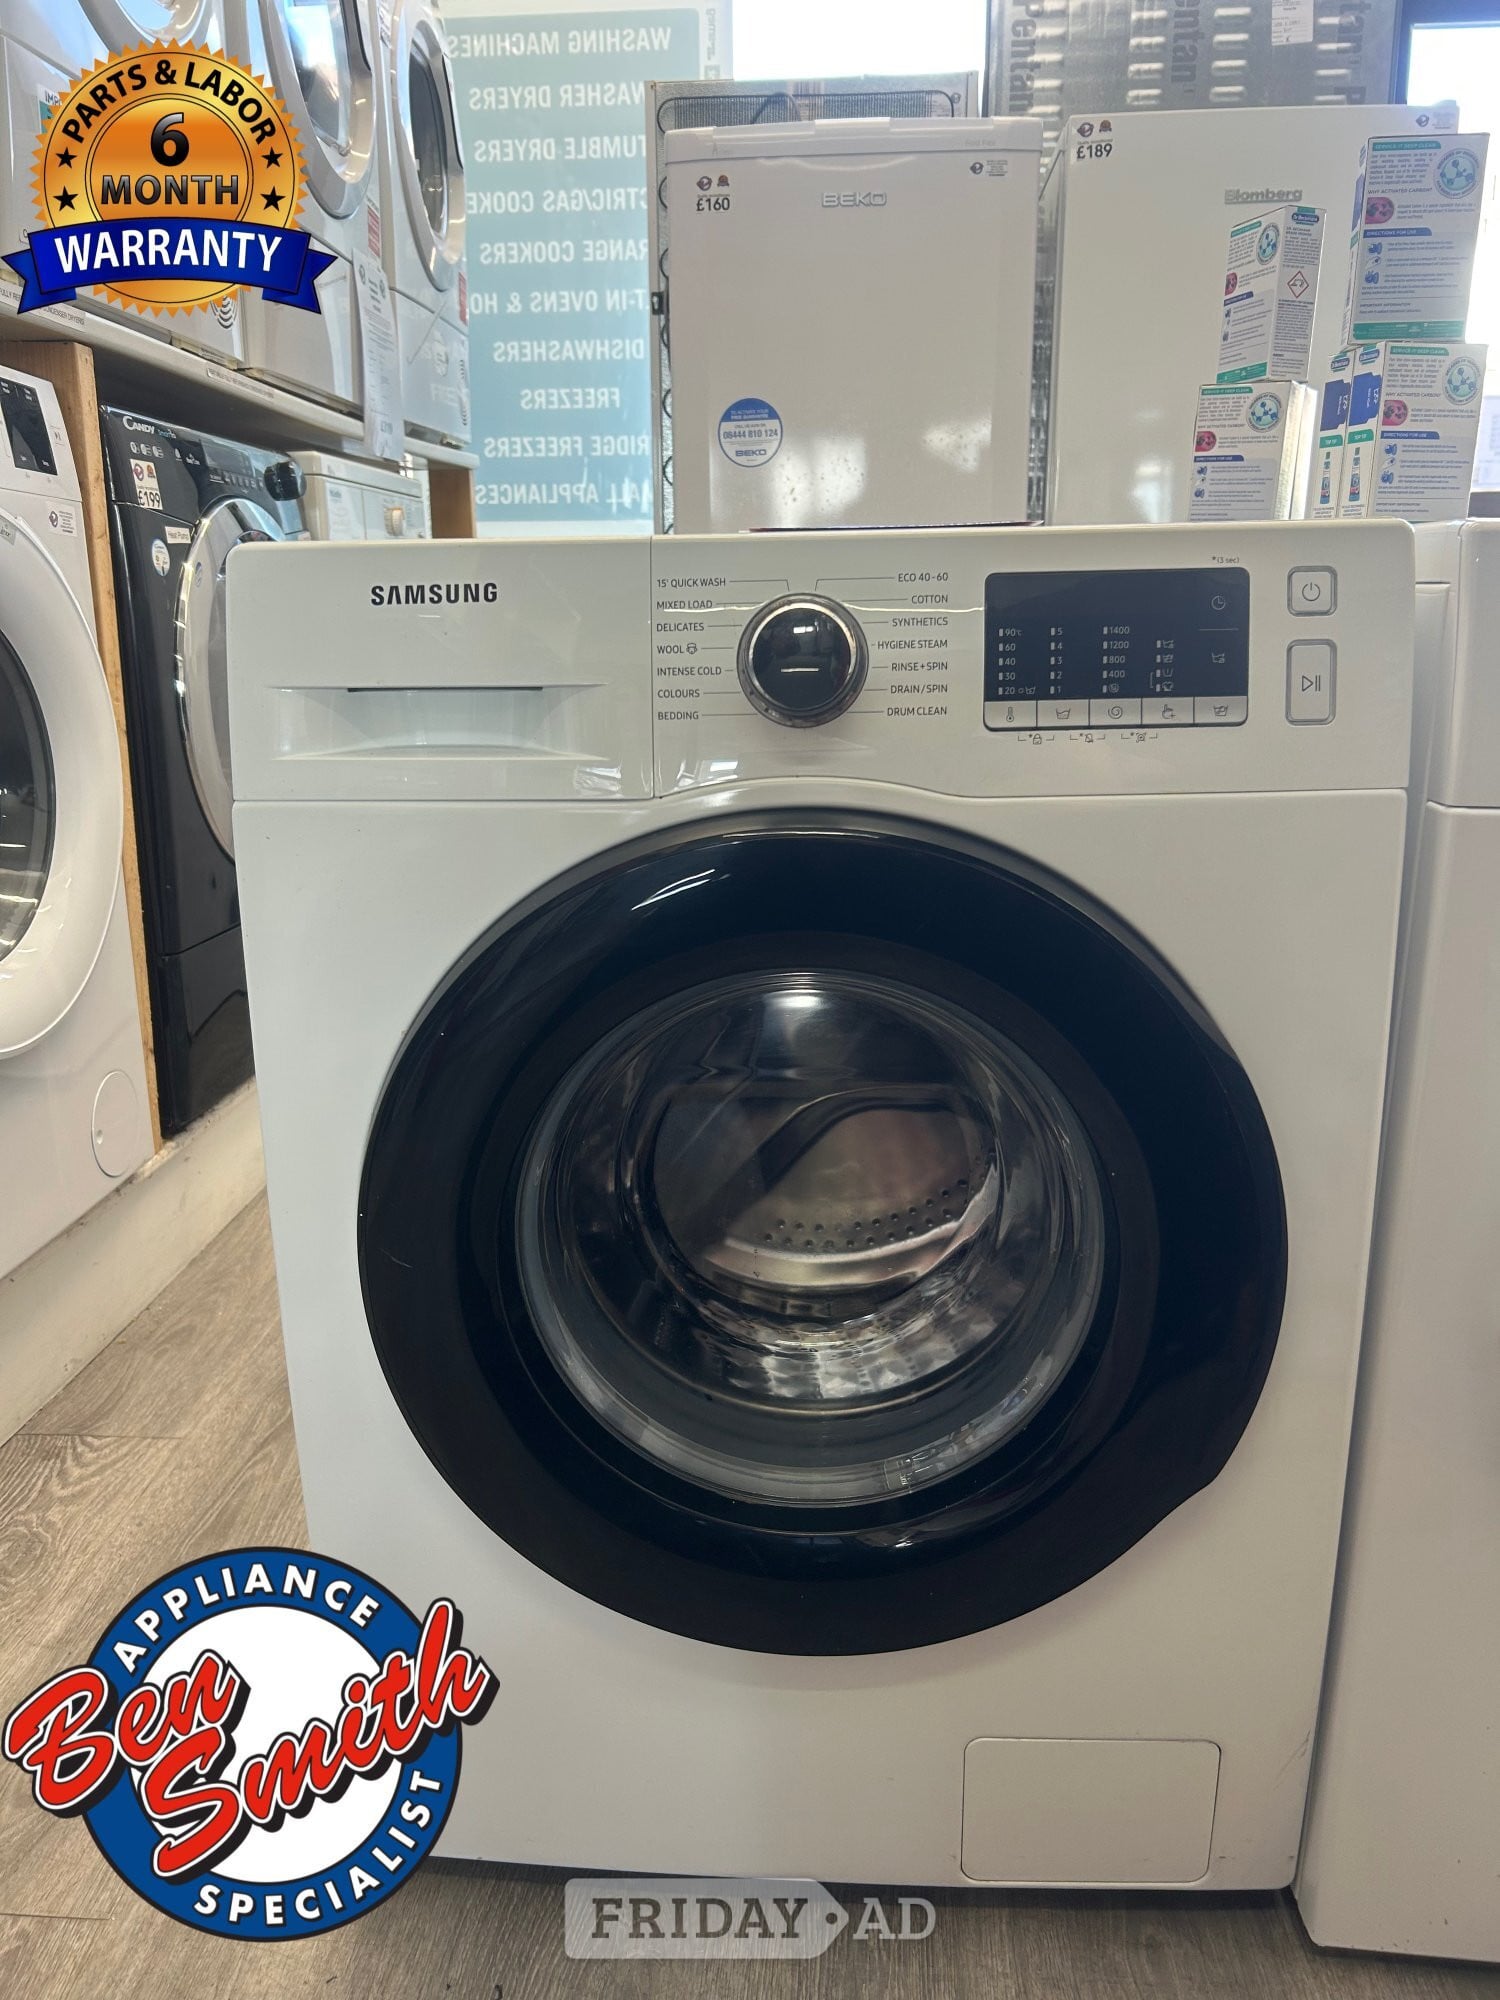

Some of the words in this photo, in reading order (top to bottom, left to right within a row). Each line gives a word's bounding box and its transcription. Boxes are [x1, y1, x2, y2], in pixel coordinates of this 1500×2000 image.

[1076, 143, 1113, 160] £189
[821, 192, 887, 208] BEKO
[1224, 188, 1303, 204] Blomberg
[696, 197, 730, 212] £160
[735, 449, 767, 457] BEKO
[138, 490, 160, 508] £199
[898, 573, 916, 582] ECO
[671, 578, 699, 589] QUICK
[700, 577, 726, 587] WASH
[371, 582, 497, 605] SAMSUNG
[911, 594, 948, 604] COTTON
[656, 600, 686, 610] MIXED
[688, 600, 713, 609] LOAD
[656, 622, 704, 632] DELICATES
[892, 617, 948, 627] SYNTHETICS
[1057, 627, 1063, 636] 5
[1109, 626, 1130, 635] 1400
[656, 644, 684, 654] WOOL
[877, 640, 916, 650] HYGIENE
[917, 639, 948, 649] STEAM
[1004, 643, 1016, 651] 60
[1057, 642, 1063, 651] 4
[1109, 640, 1129, 650] 1200
[1004, 657, 1016, 666] 40
[1057, 656, 1063, 665] 3
[1108, 655, 1126, 664] 800
[657, 667, 695, 677] INTENSE
[697, 666, 722, 676] COLD
[1004, 672, 1016, 681] 30
[1056, 671, 1062, 680] 2
[1108, 670, 1126, 679] 400
[657, 689, 700, 699] COLOURS
[1004, 686, 1016, 695] 20
[657, 711, 699, 721] BEDDING
[887, 707, 915, 717] DRUM
[916, 706, 948, 716] CLEAN
